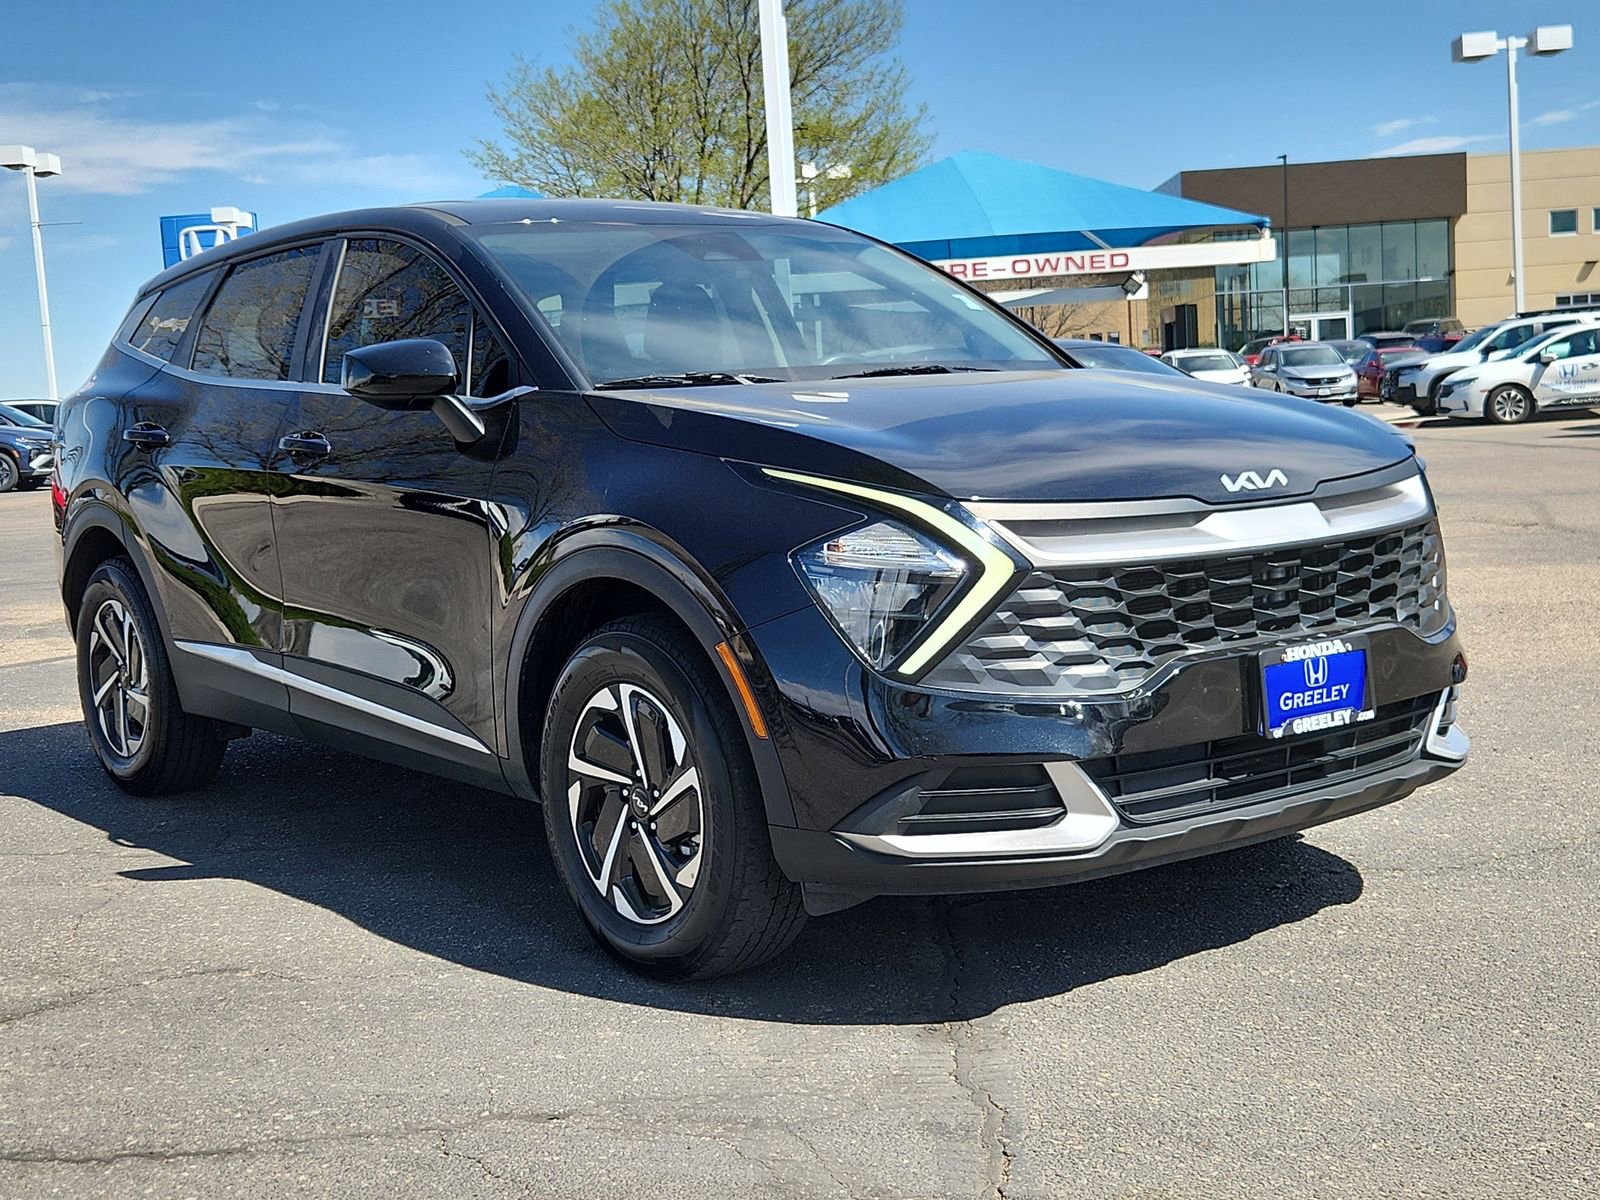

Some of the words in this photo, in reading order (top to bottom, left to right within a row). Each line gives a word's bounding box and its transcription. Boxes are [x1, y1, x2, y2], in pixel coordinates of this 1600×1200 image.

[1220, 468, 1289, 492] KIA
[1284, 639, 1347, 662] HONDA
[1279, 683, 1351, 711] GREELEY
[1292, 708, 1352, 735] GREELEY
[541, 690, 561, 785] TERRAIN
